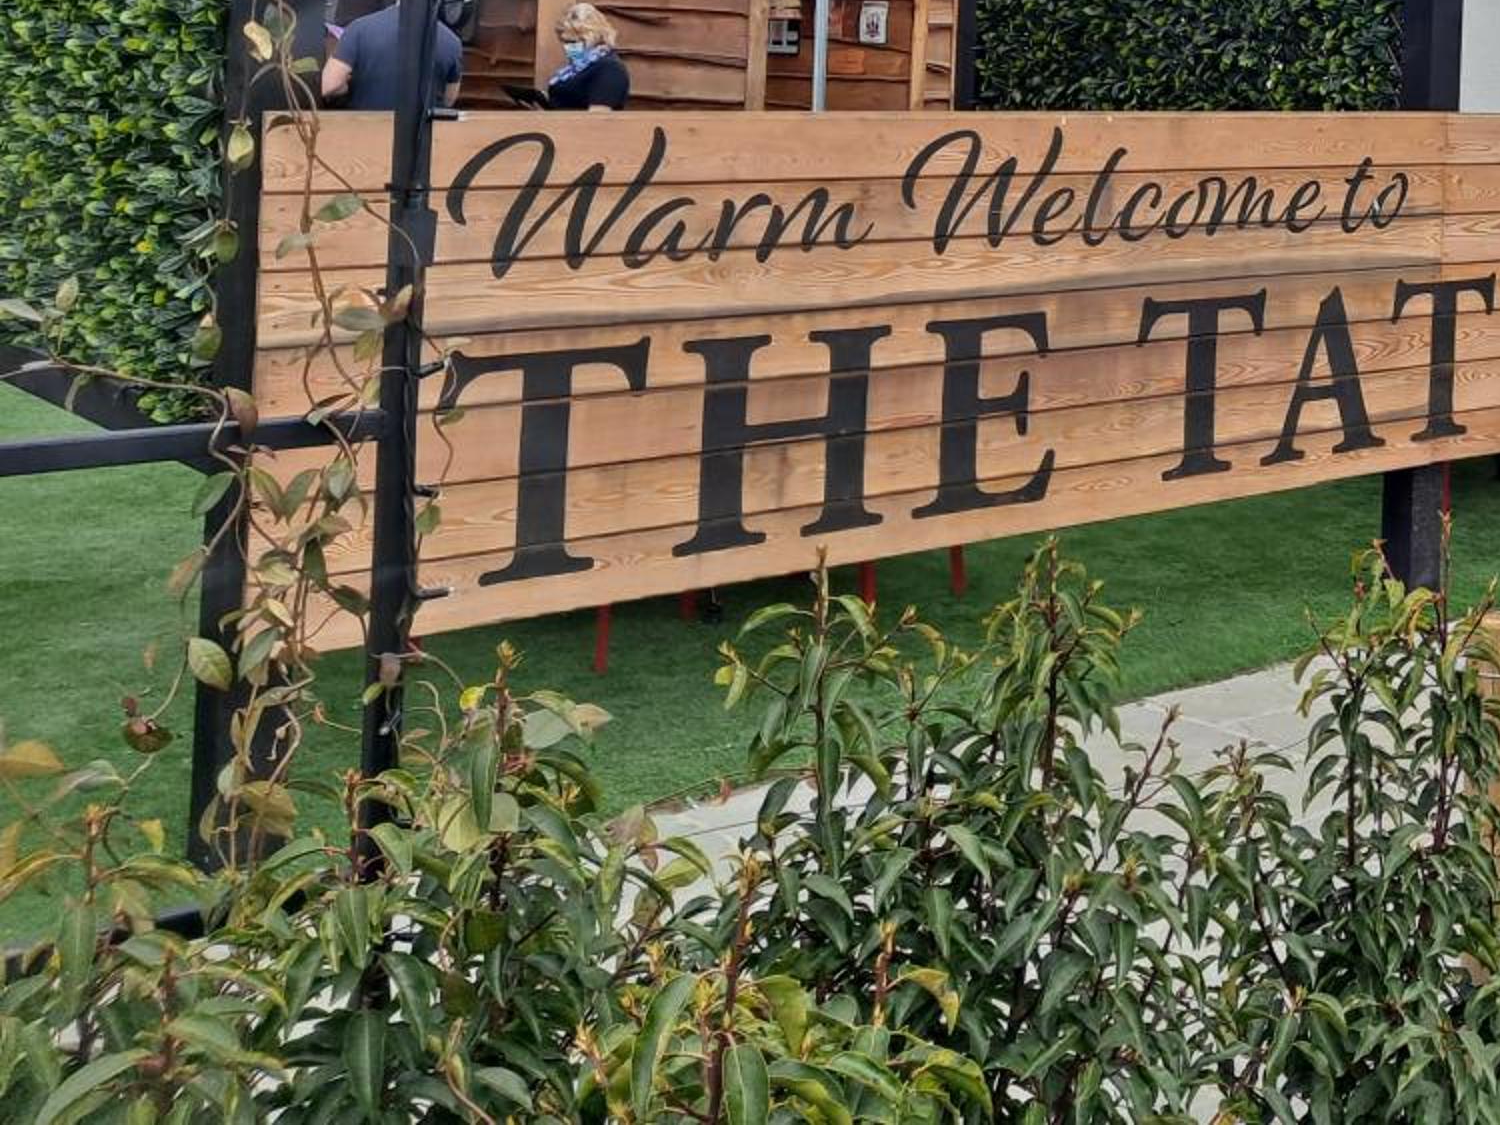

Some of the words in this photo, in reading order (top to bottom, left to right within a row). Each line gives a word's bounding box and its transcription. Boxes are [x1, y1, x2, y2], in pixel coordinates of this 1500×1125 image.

[446, 125, 875, 280] Warm
[902, 125, 1328, 256] Welcome
[1339, 155, 1411, 234] to
[436, 310, 1056, 587] THE
